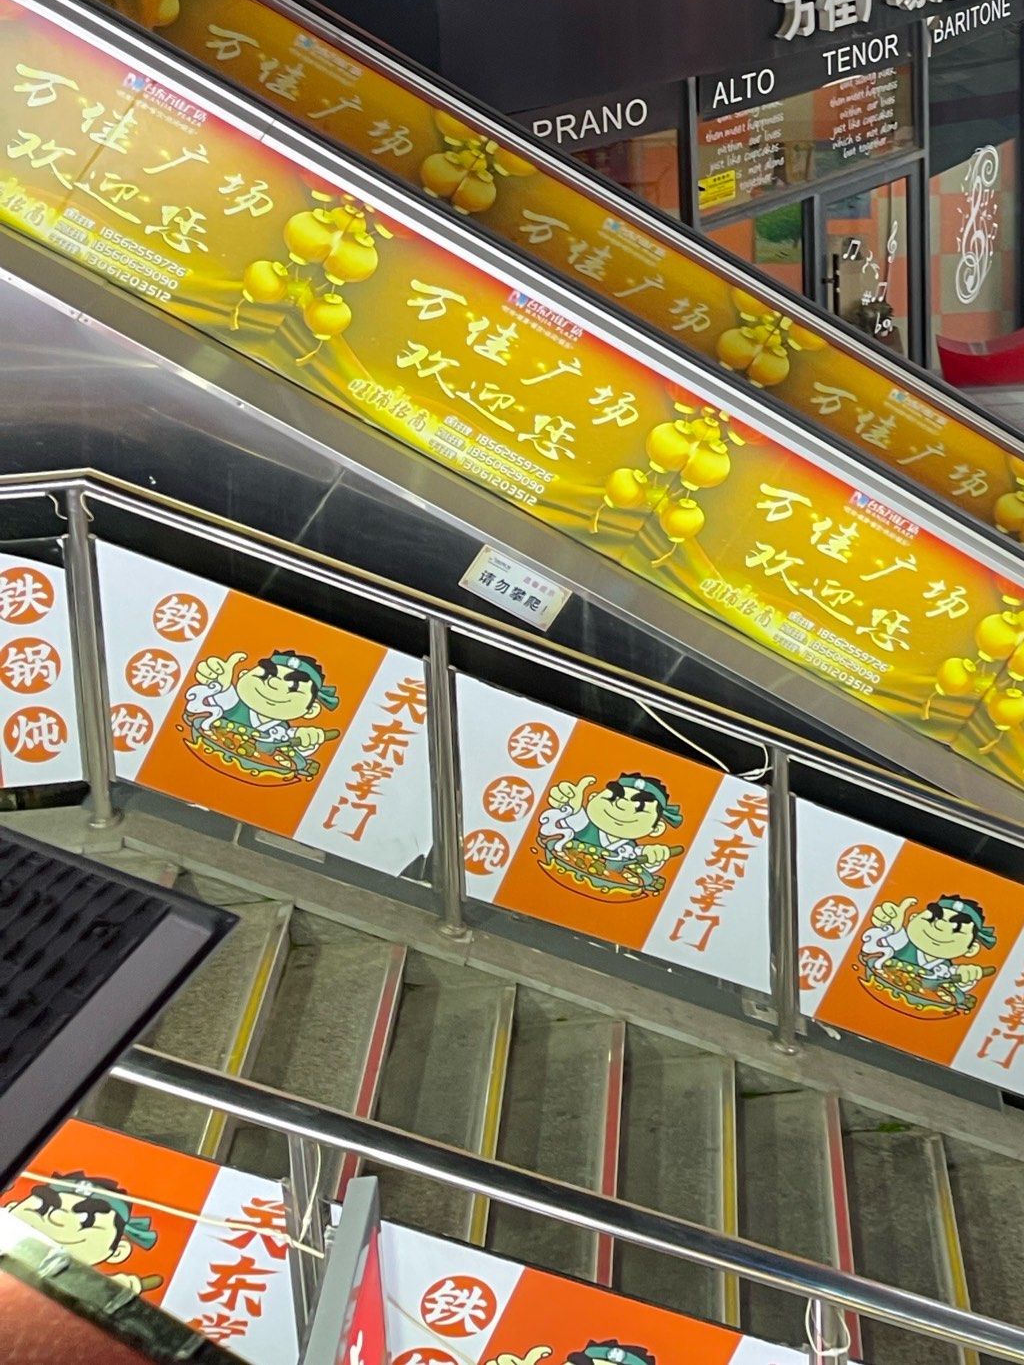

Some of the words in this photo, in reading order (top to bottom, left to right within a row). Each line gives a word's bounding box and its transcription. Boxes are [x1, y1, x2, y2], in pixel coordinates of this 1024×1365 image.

[206, 24, 415, 158] 万佳广场
[711, 67, 775, 109] ALTO
[822, 33, 900, 77] TENOR
[13, 63, 275, 221] 万佳广场
[91, 240, 180, 291] 18560629090
[100, 226, 187, 277] 18562559726
[520, 208, 712, 334] 万佳广场
[406, 278, 639, 428] 万佳广场
[467, 446, 546, 495] 18560629090
[476, 434, 553, 483] 18562559726
[809, 381, 989, 499] 万佳广场
[758, 482, 971, 621] 万佳广场
[111, 596, 203, 746] 铁锅炖
[817, 627, 889, 673] 18562559726
[321, 676, 428, 843] 关东掌门
[465, 722, 556, 874] 铁锅炖
[669, 793, 769, 952] 关东掌门
[799, 846, 881, 987] 铁锅炖
